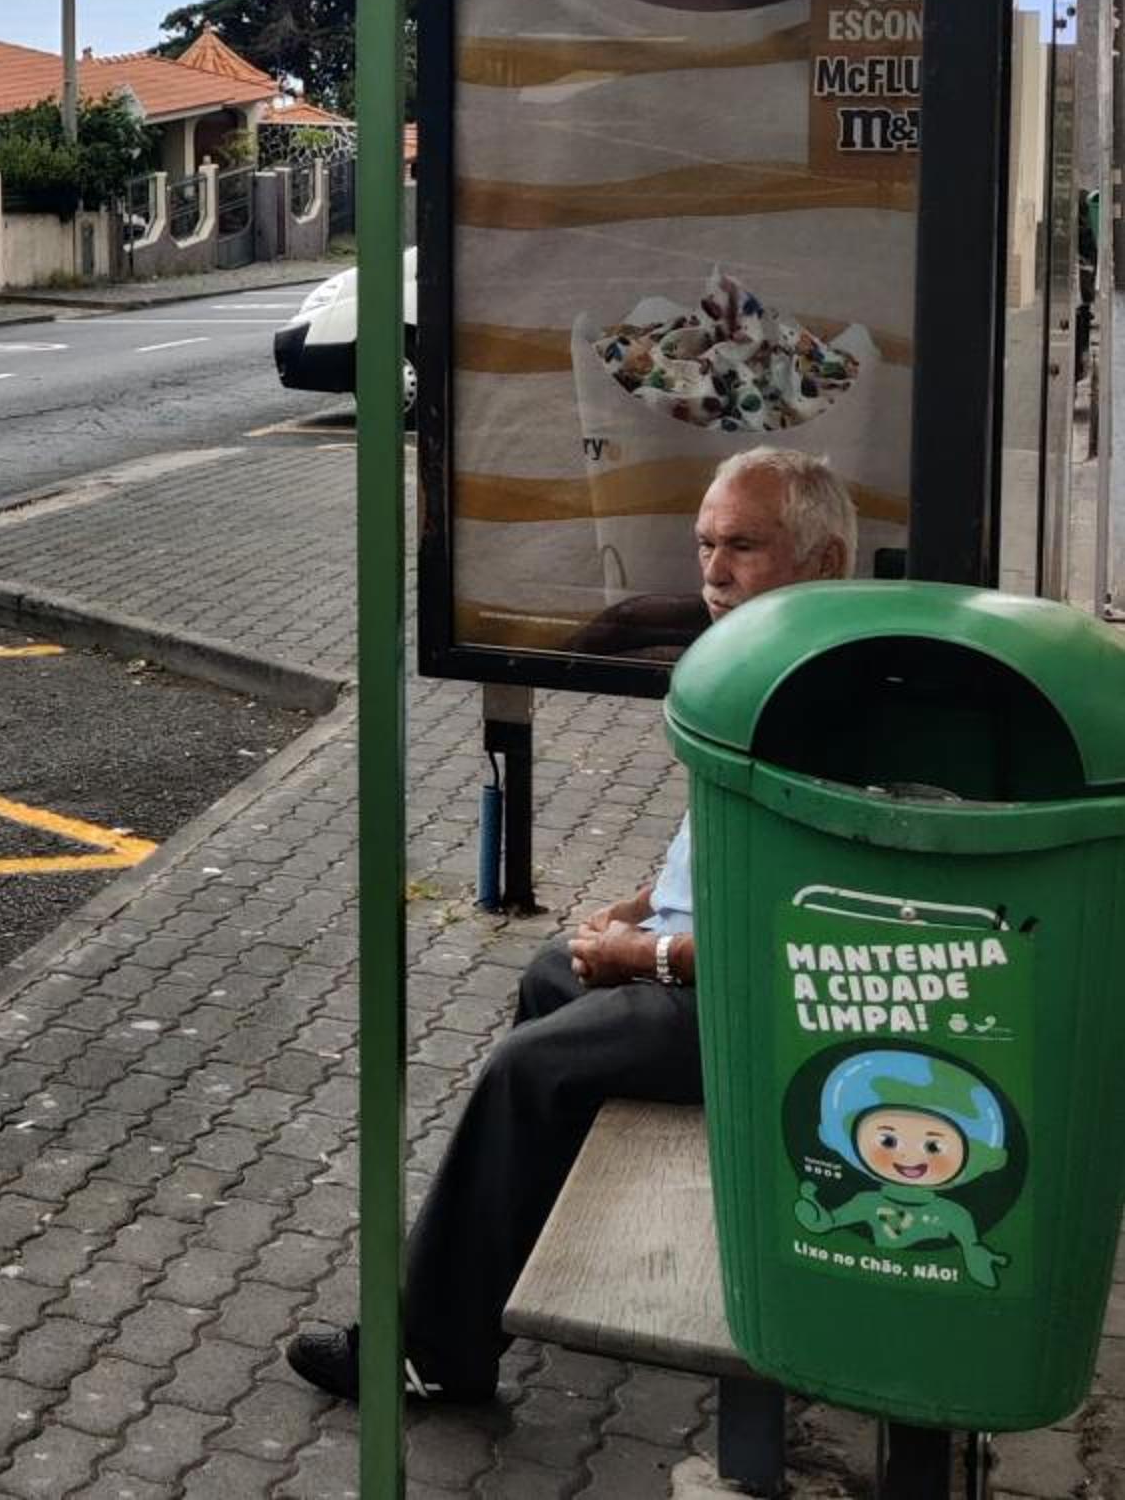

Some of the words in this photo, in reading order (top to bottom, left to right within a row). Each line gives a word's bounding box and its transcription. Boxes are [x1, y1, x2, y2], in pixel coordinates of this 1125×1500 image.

[828, 9, 924, 42] ESCON
[786, 938, 1008, 972] MANTENHA
[794, 973, 818, 1001] A
[828, 972, 969, 1002] CIDADE
[797, 1003, 929, 1032] LIMPA!
[833, 1252, 855, 1266] no
[913, 1263, 959, 1282] NÃO!
